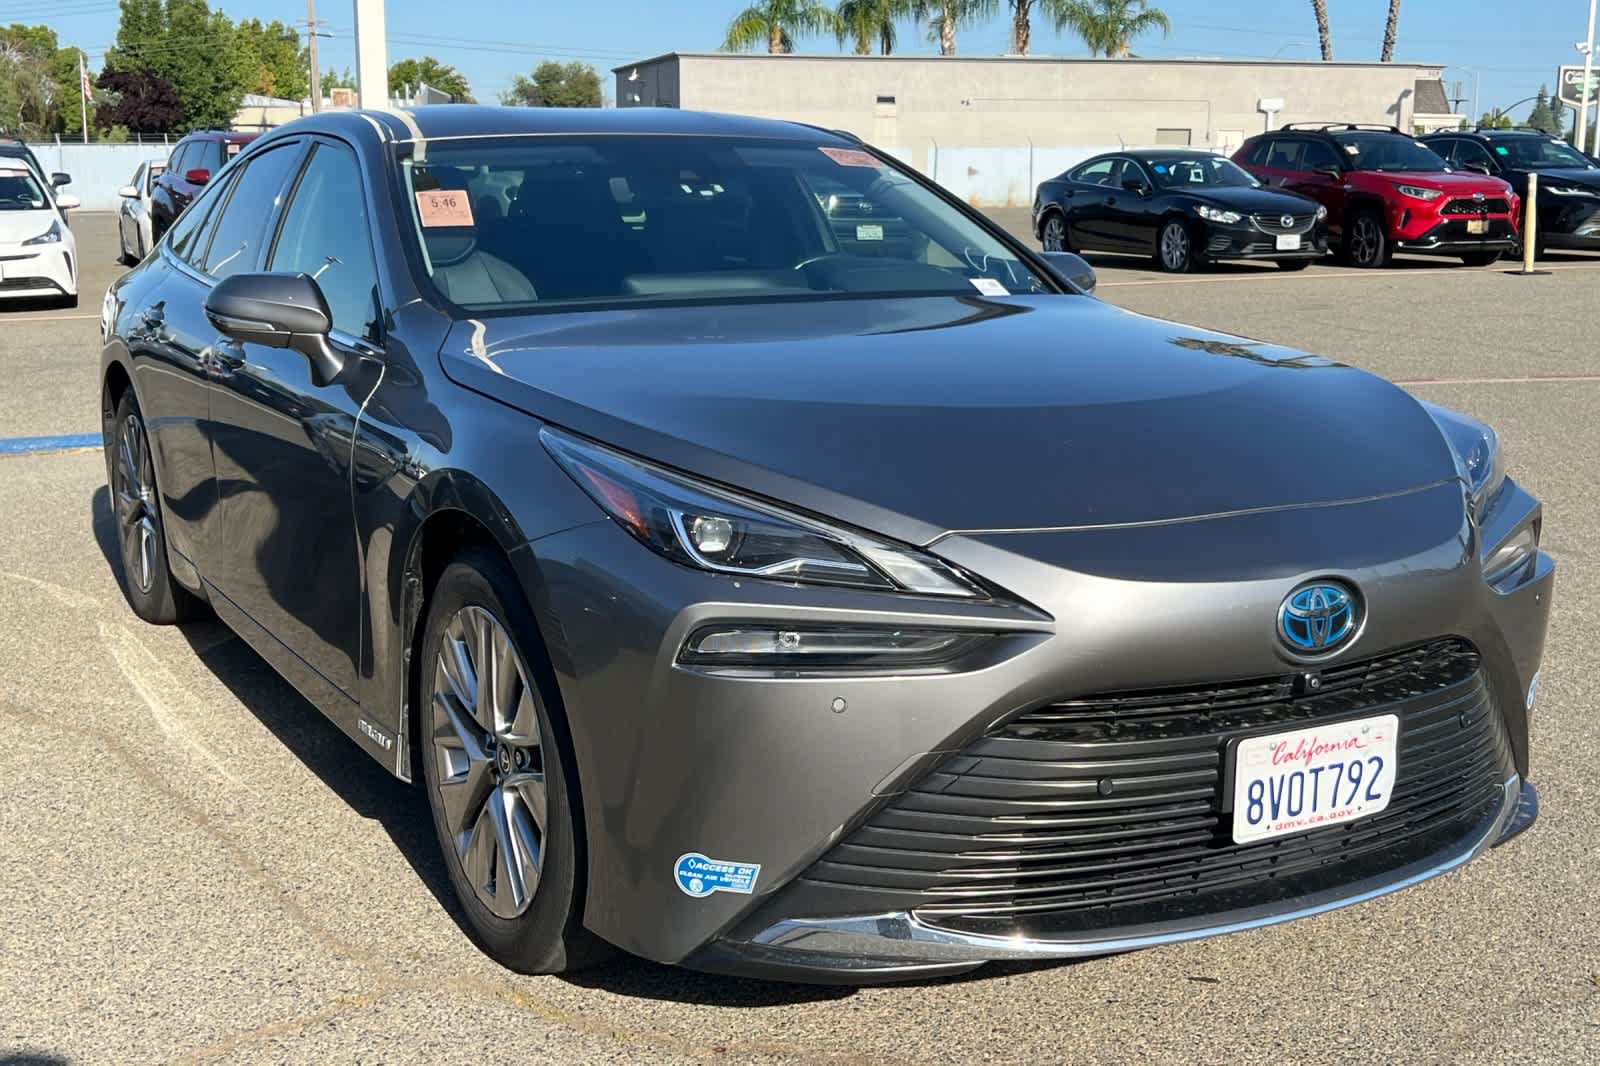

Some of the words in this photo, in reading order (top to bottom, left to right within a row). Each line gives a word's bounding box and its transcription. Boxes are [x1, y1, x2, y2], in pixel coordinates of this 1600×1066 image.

[1272, 736, 1367, 767] California
[1246, 755, 1384, 826] 8VOT792
[1275, 808, 1354, 831] dmv.ca.gov
